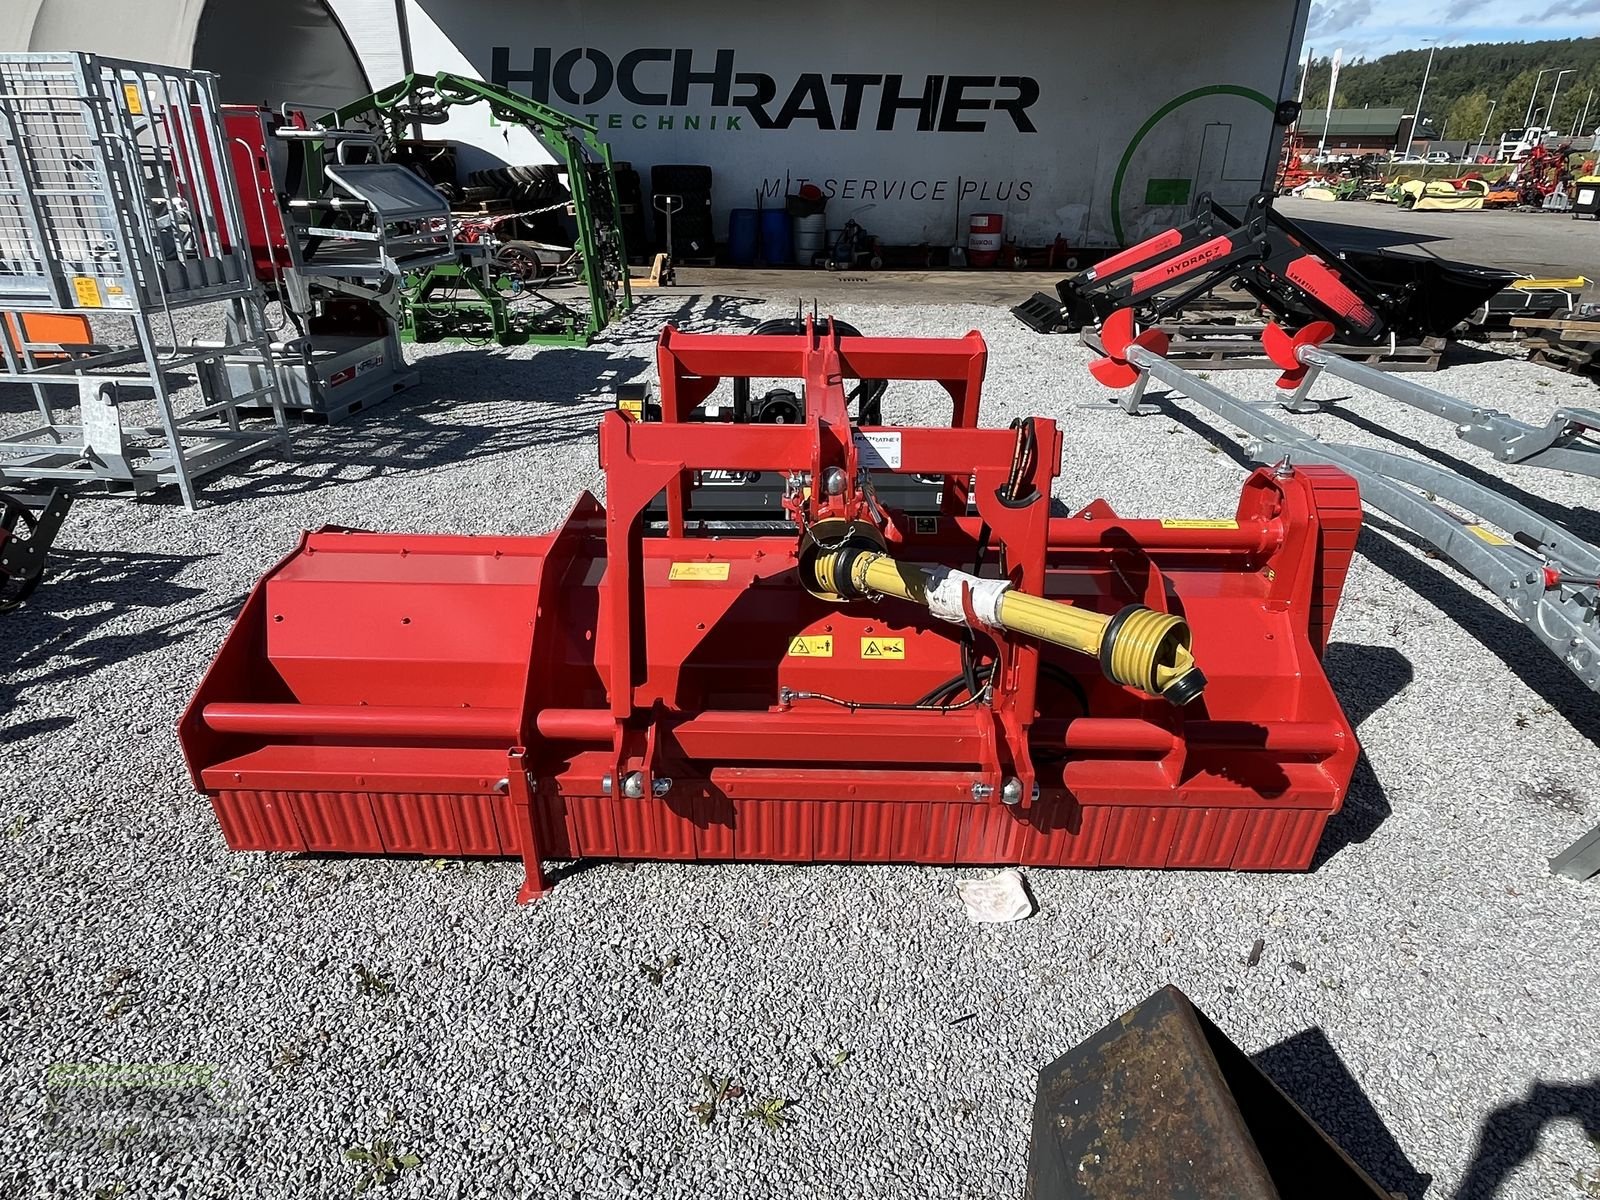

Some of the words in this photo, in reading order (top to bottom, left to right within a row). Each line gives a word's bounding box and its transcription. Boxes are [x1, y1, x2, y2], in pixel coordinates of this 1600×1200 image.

[824, 179, 948, 200] SERVICE
[961, 181, 1033, 201] PLUS
[1166, 250, 1213, 275] HYDRAC
